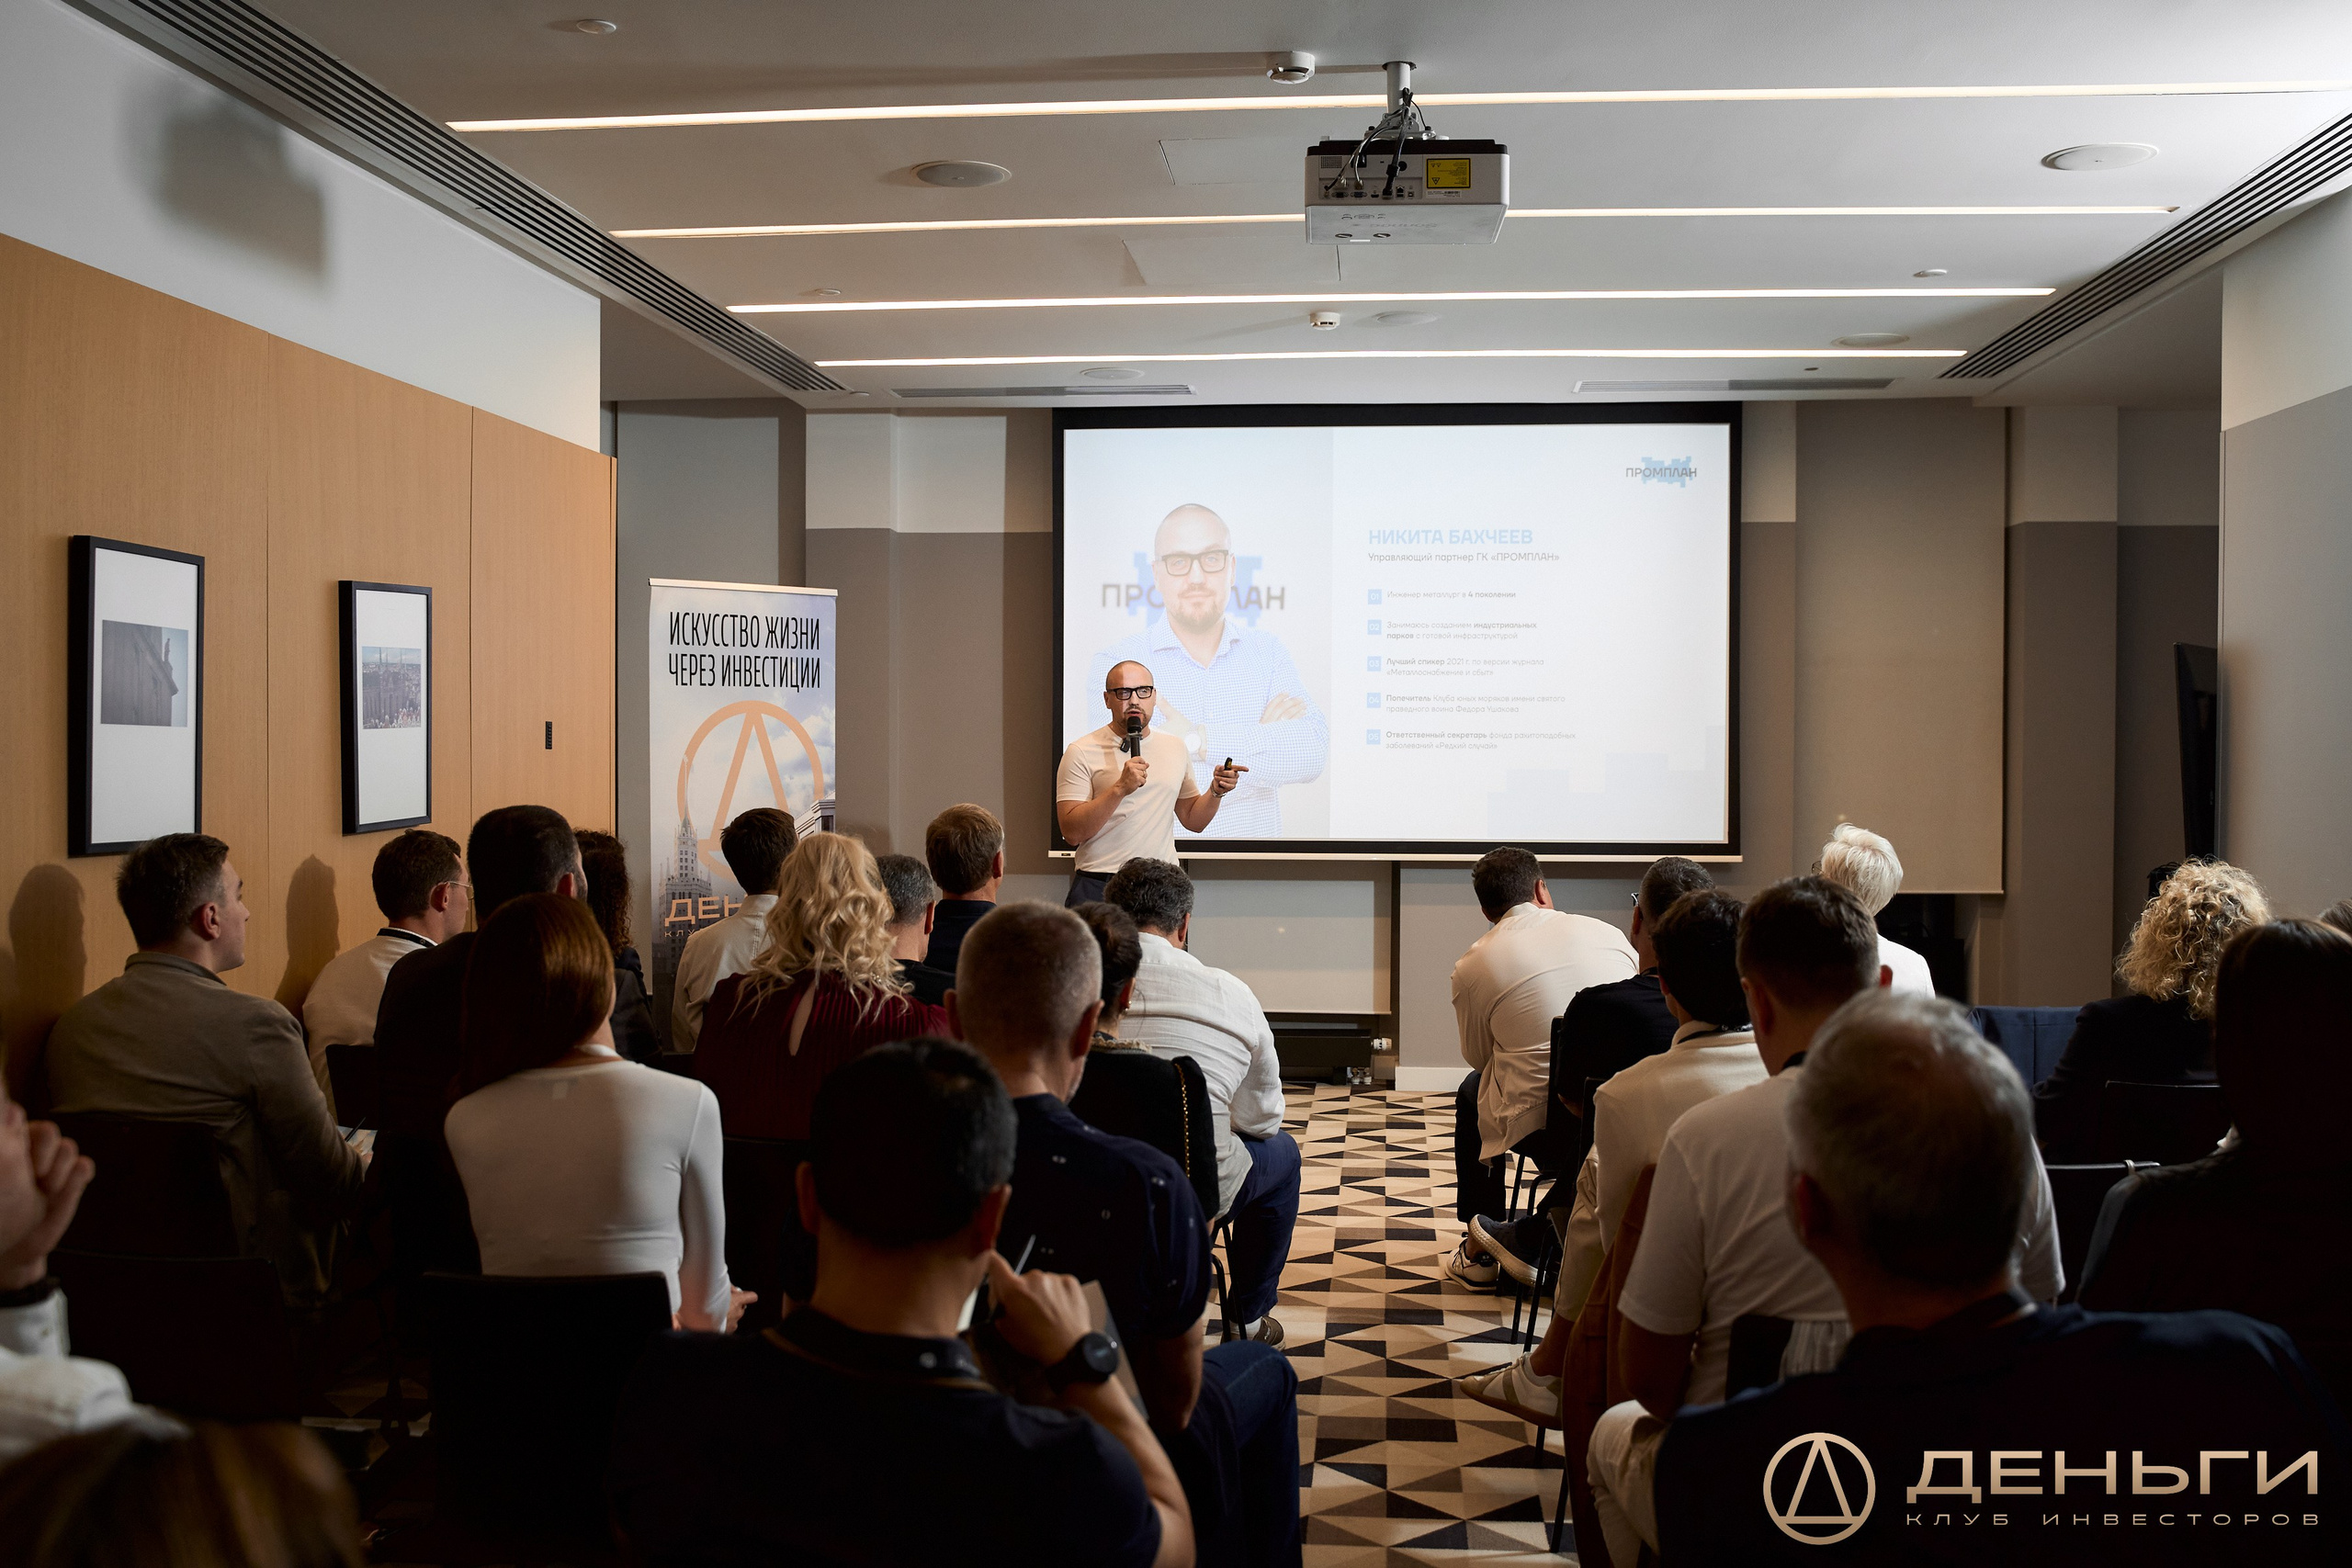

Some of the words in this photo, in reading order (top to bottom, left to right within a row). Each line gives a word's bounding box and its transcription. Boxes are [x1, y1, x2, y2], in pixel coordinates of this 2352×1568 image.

[1626, 468, 1697, 477] ПРОМПЛАН
[1368, 530, 1444, 545] НИКИТА
[1449, 530, 1532, 545] БАХЧЕЕВ
[1368, 553, 1432, 563] Управляющий
[1436, 554, 1474, 563] партнер
[1476, 553, 1488, 561] ГК
[1491, 553, 1559, 561] «ПРОМПЛАН»
[1102, 584, 1285, 609] ПРОЛАН
[1386, 621, 1430, 629] Занимаюсь
[670, 611, 760, 649] ИСКУССТВО
[765, 616, 820, 650] ЖИЗНИ
[1453, 632, 1518, 640] инфраструктурой
[1386, 658, 1416, 666] Лучший
[669, 653, 716, 687] ЧЕРЕЗ
[721, 654, 821, 693] ИНВЕСТИЦИИ
[1468, 742, 1498, 750] случай»
[665, 894, 748, 927] ДЕН
[665, 929, 704, 937] КЛУ
